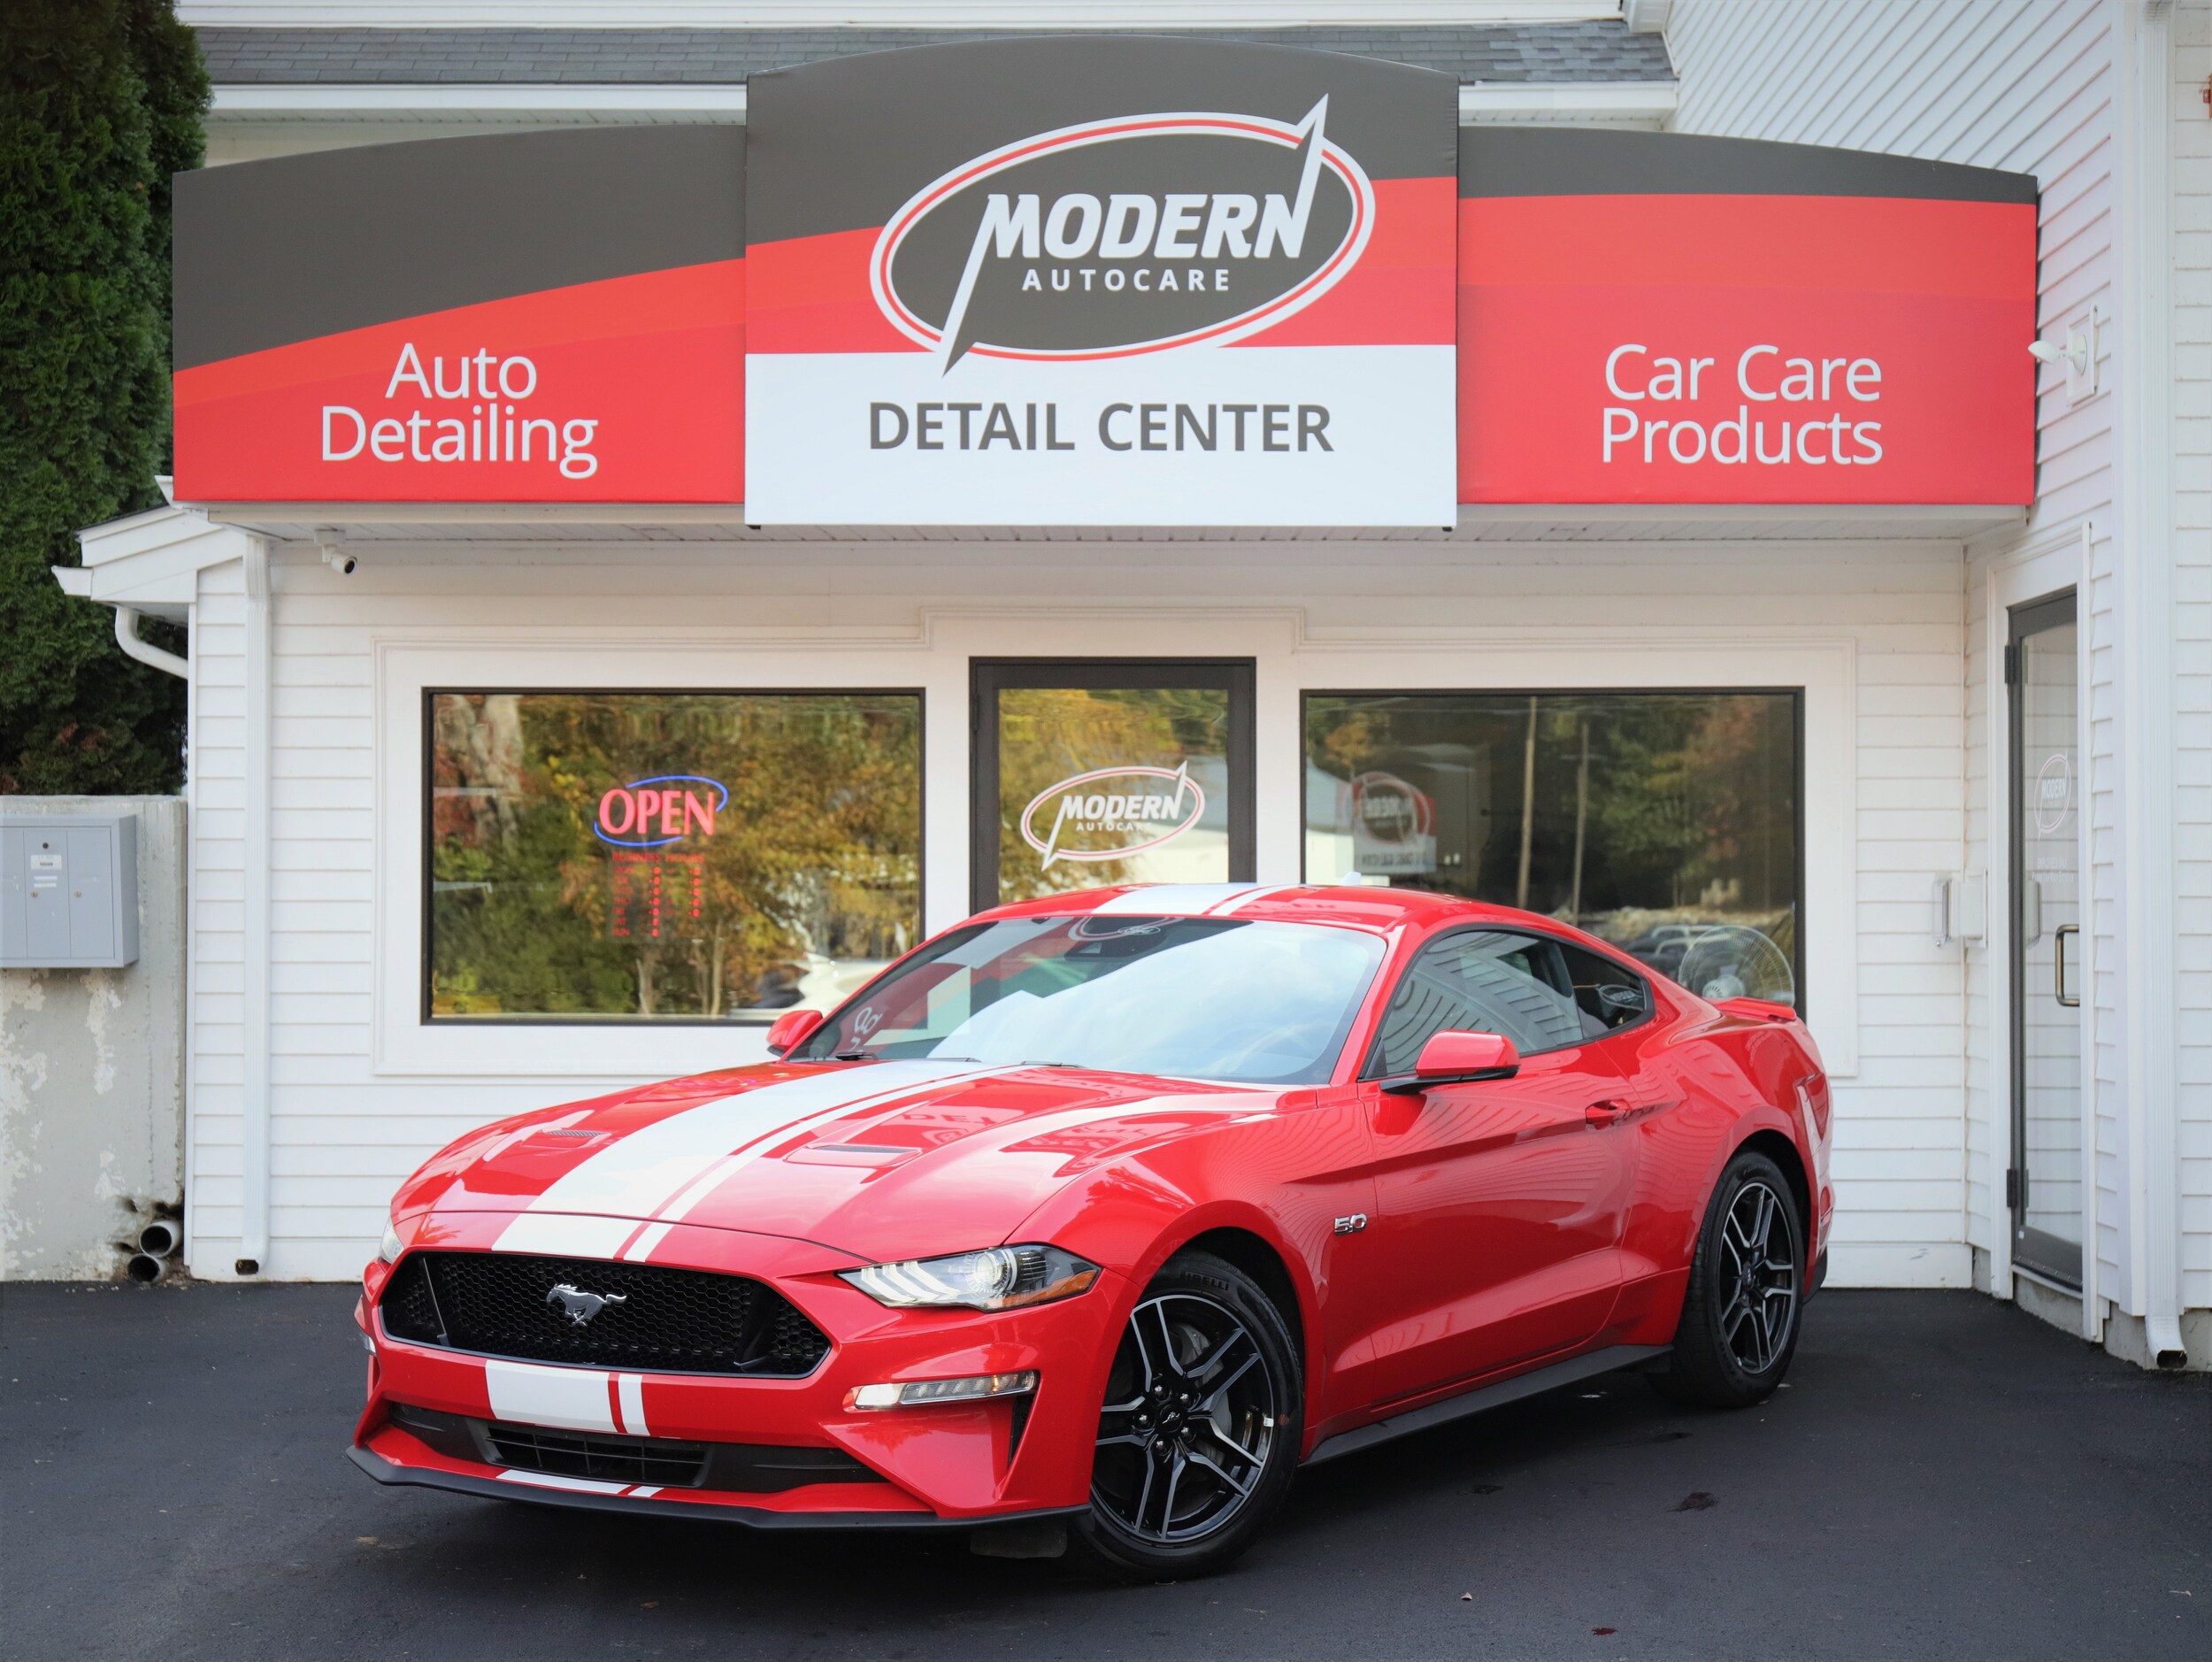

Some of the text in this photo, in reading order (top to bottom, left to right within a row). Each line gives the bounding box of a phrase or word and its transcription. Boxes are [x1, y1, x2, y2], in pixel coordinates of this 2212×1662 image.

[1021, 268, 1230, 292] AUTOCARE
[384, 342, 537, 399] Auto
[1605, 343, 1882, 401] Car Care
[322, 403, 599, 479] Detailing
[869, 402, 1335, 452] DETAIL CENTER
[1602, 404, 1883, 465] Products
[598, 789, 715, 835] OPEN
